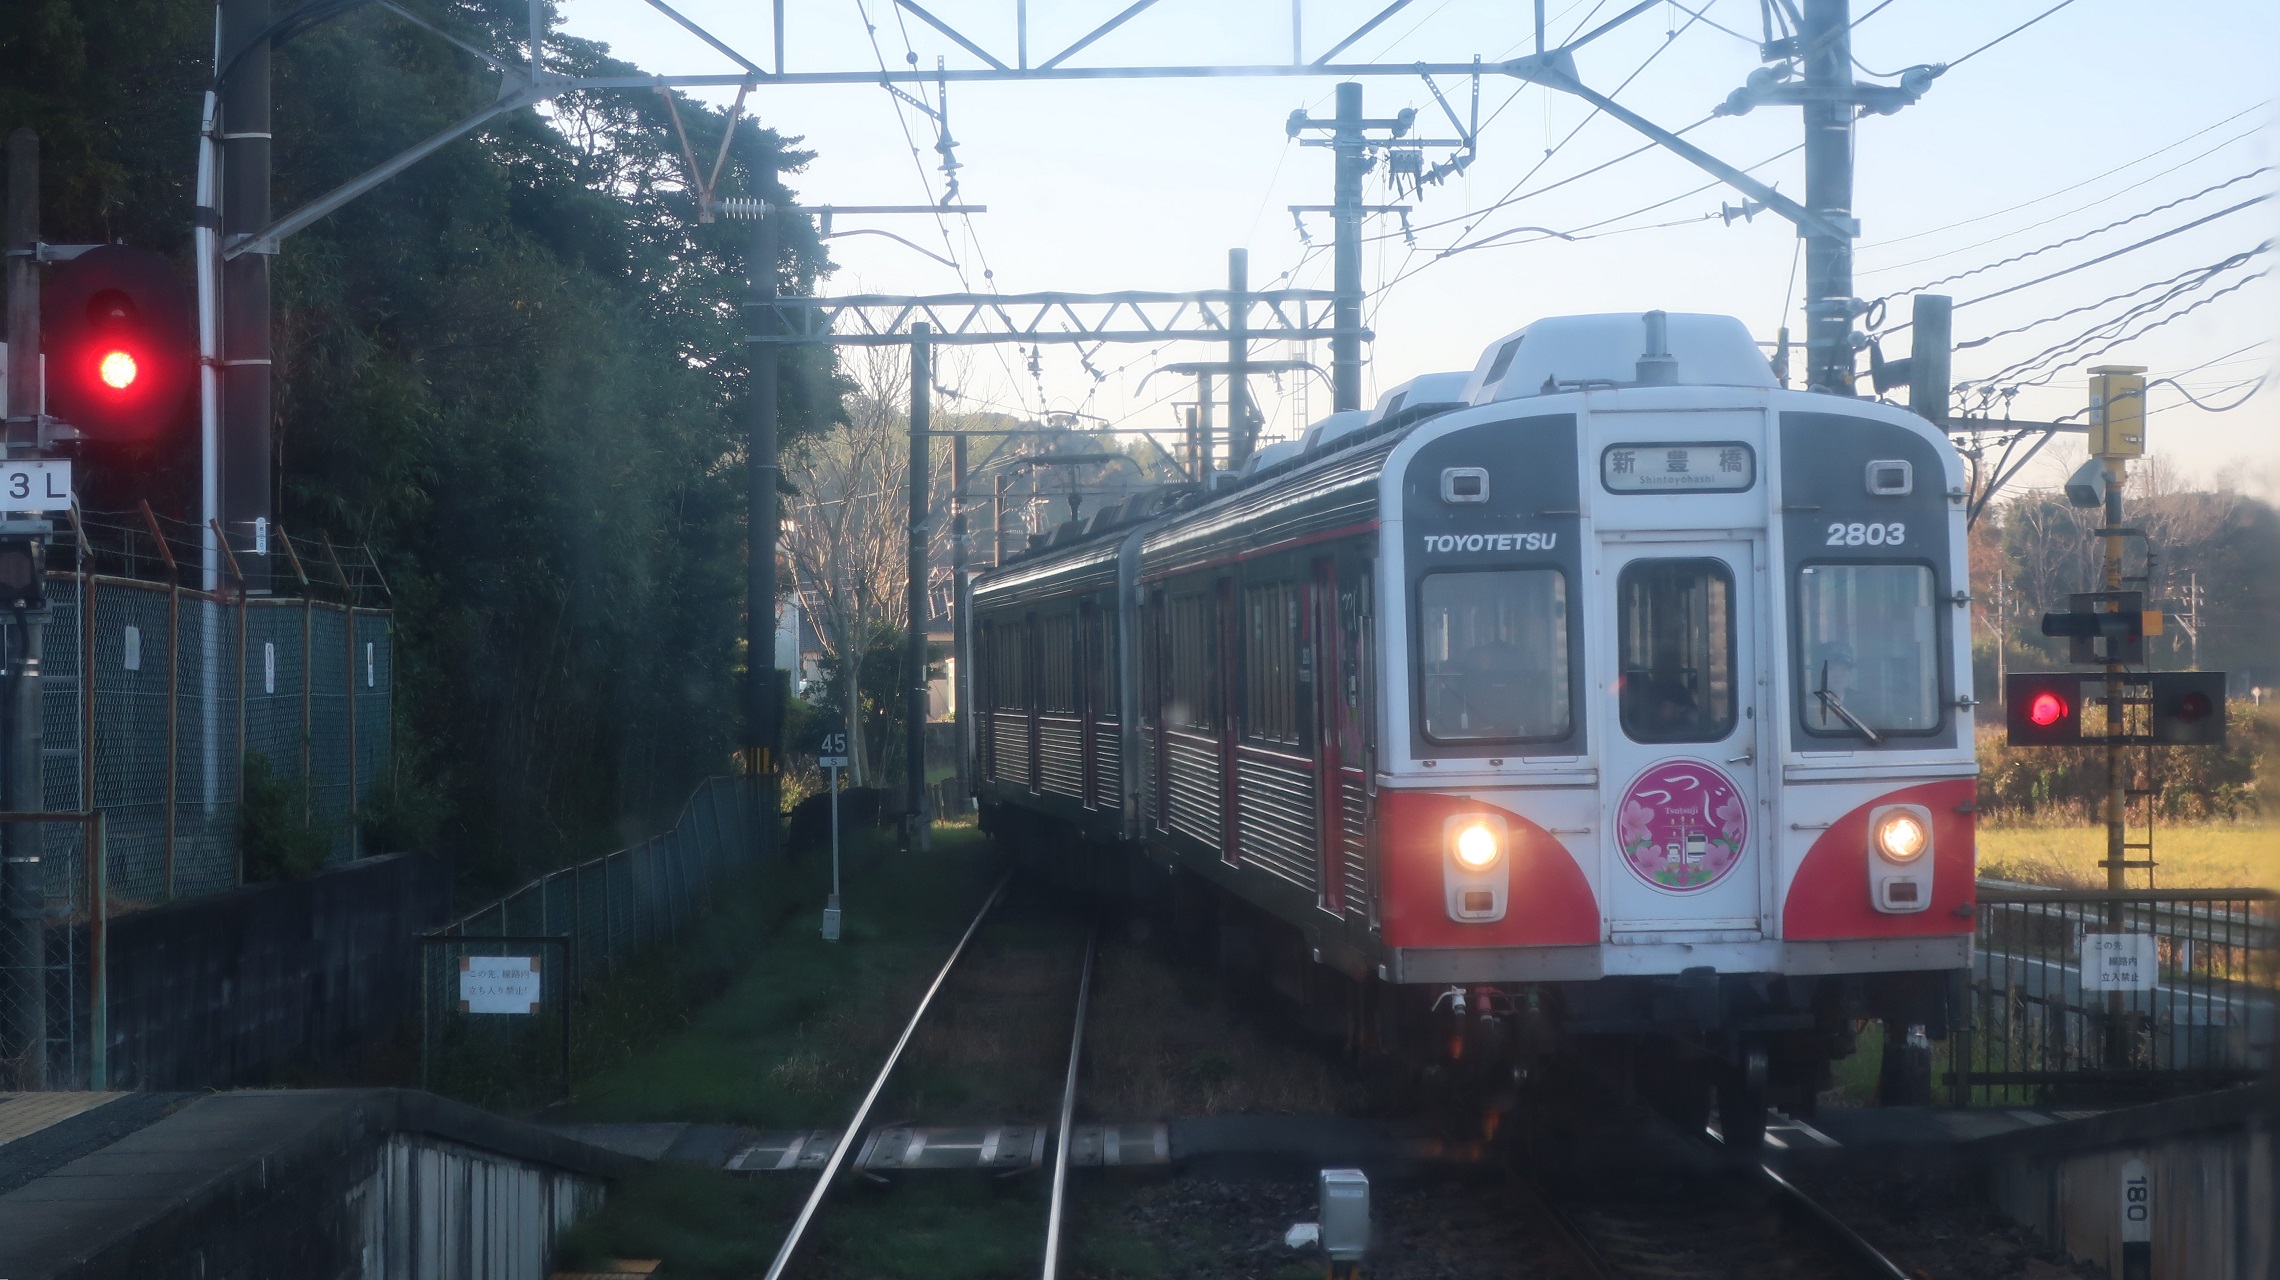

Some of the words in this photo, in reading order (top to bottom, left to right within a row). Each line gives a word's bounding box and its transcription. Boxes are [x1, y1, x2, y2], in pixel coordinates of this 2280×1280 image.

[1612, 450, 1743, 474] 新豊橋
[1640, 475, 1715, 485] Shintoyohashi
[1826, 523, 1905, 546] 2803
[1424, 533, 1557, 552] TOYOTETSU
[821, 733, 846, 753] 45
[830, 758, 838, 766] S
[1635, 775, 1726, 828] つつじ
[1665, 806, 1699, 816] Tsutsuji
[2095, 940, 2122, 951] この先
[2109, 956, 2138, 967] 線路内
[2101, 972, 2139, 982] 立入禁止
[2127, 1175, 2148, 1222] 180
